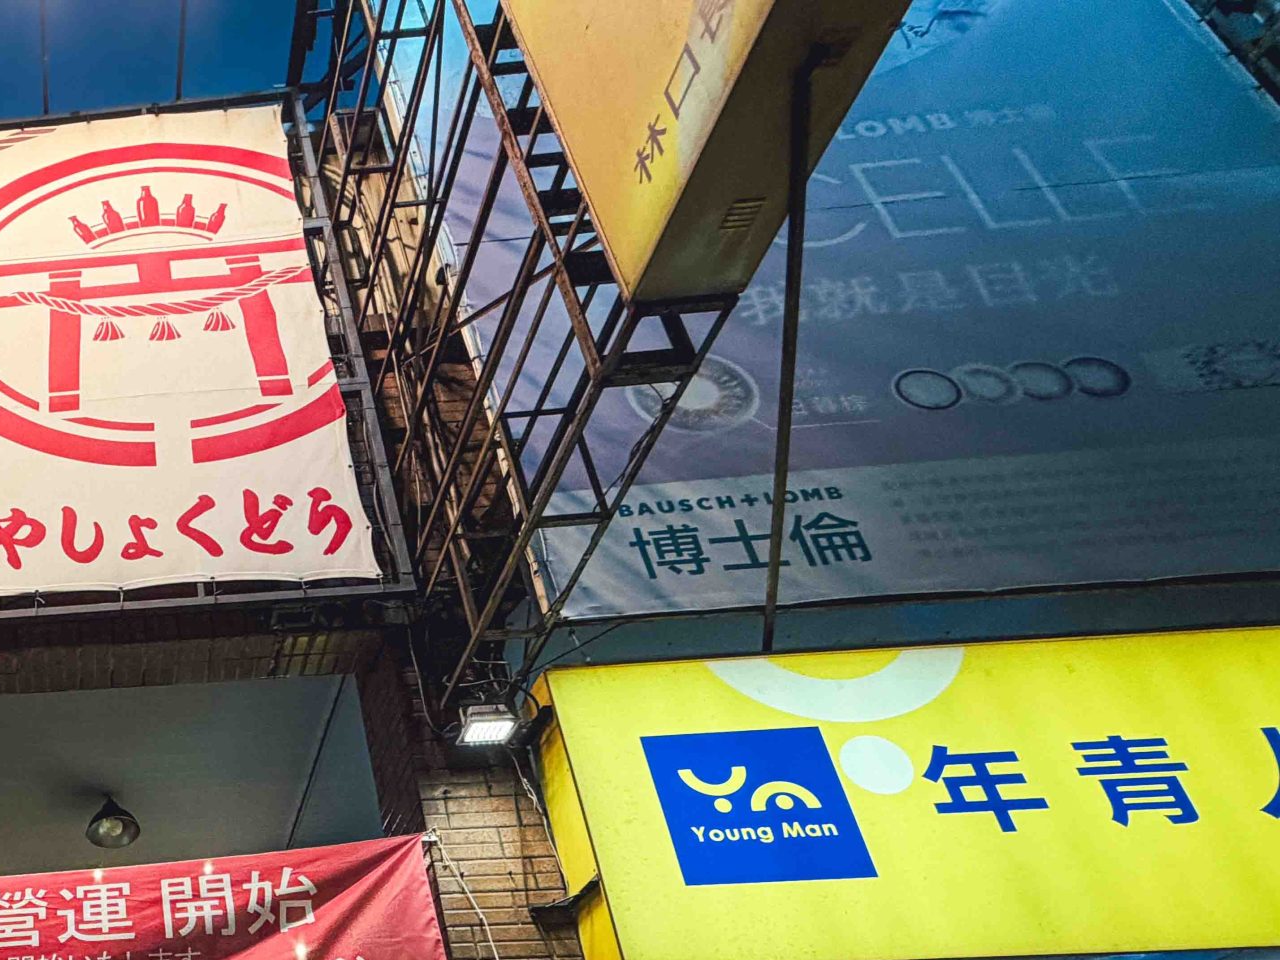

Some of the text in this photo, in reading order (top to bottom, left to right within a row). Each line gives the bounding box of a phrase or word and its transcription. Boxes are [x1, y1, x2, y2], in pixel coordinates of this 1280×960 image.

[628, 511, 873, 580] 博士倫
[690, 818, 839, 845] Young Man
